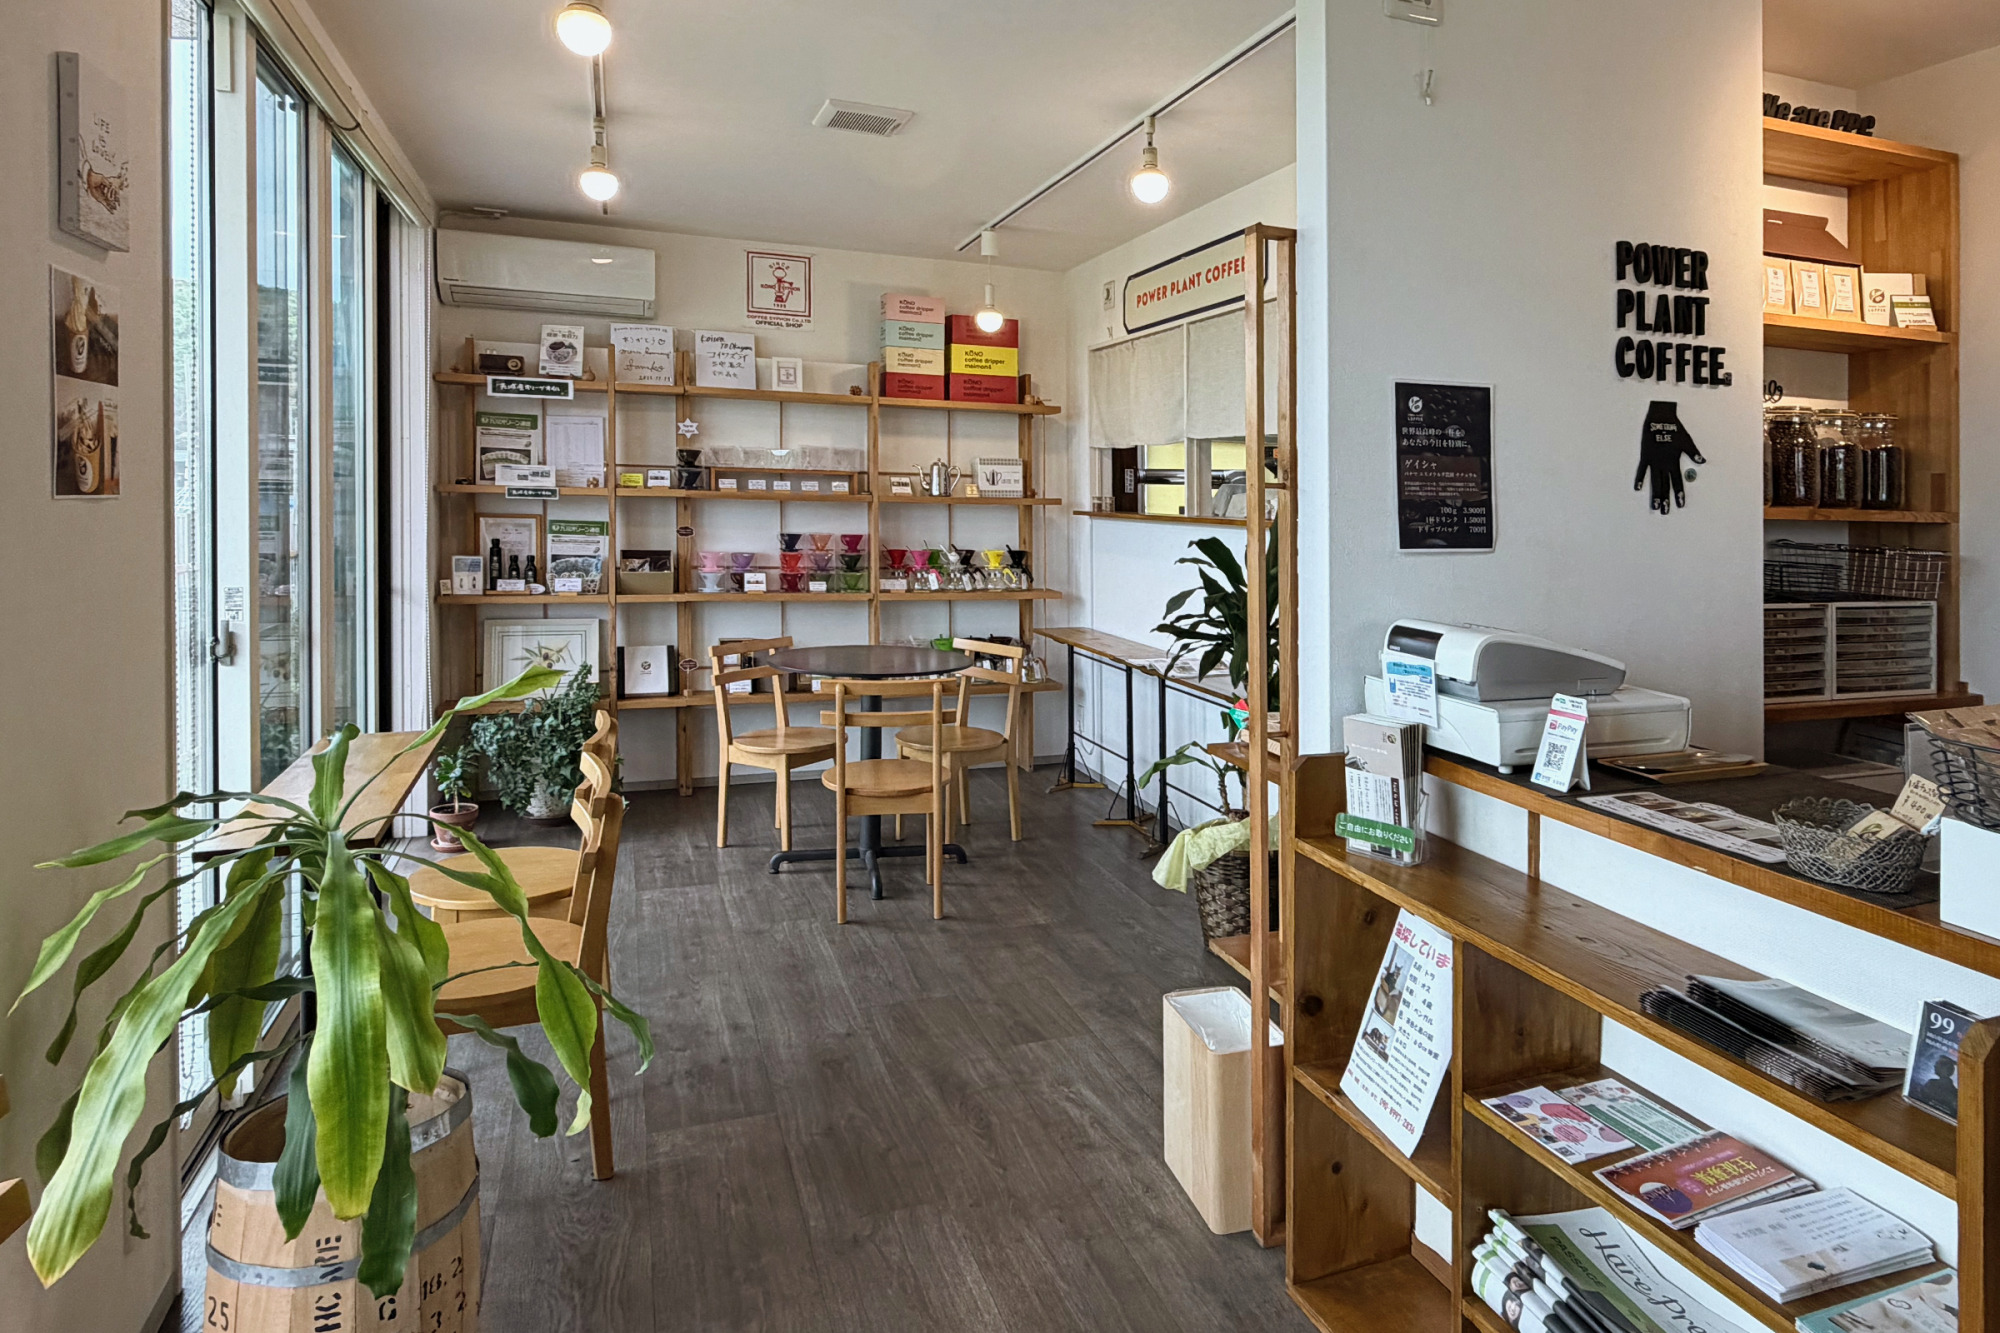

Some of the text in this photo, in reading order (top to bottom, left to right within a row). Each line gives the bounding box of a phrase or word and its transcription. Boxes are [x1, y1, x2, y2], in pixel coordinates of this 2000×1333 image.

[1790, 105, 1831, 128] are
[1615, 240, 1709, 291] POWER
[1136, 285, 1168, 308] POWER
[1170, 271, 1202, 296] PLANT
[755, 319, 784, 328] OFFICIAL
[1615, 288, 1711, 338] PLANT
[984, 358, 1006, 366] dripper
[1655, 434, 1673, 442] ELSE
[1405, 459, 1438, 470] ゲイシャ
[1418, 526, 1487, 534] ドリップバッグ 700円
[1557, 722, 1578, 735] PayPay
[1338, 821, 1413, 845] ご自由にお取りください
[1689, 1155, 1758, 1187] 生徒募集
[1550, 1235, 1607, 1289] PASSAGE
[207, 1295, 230, 1332] 25
